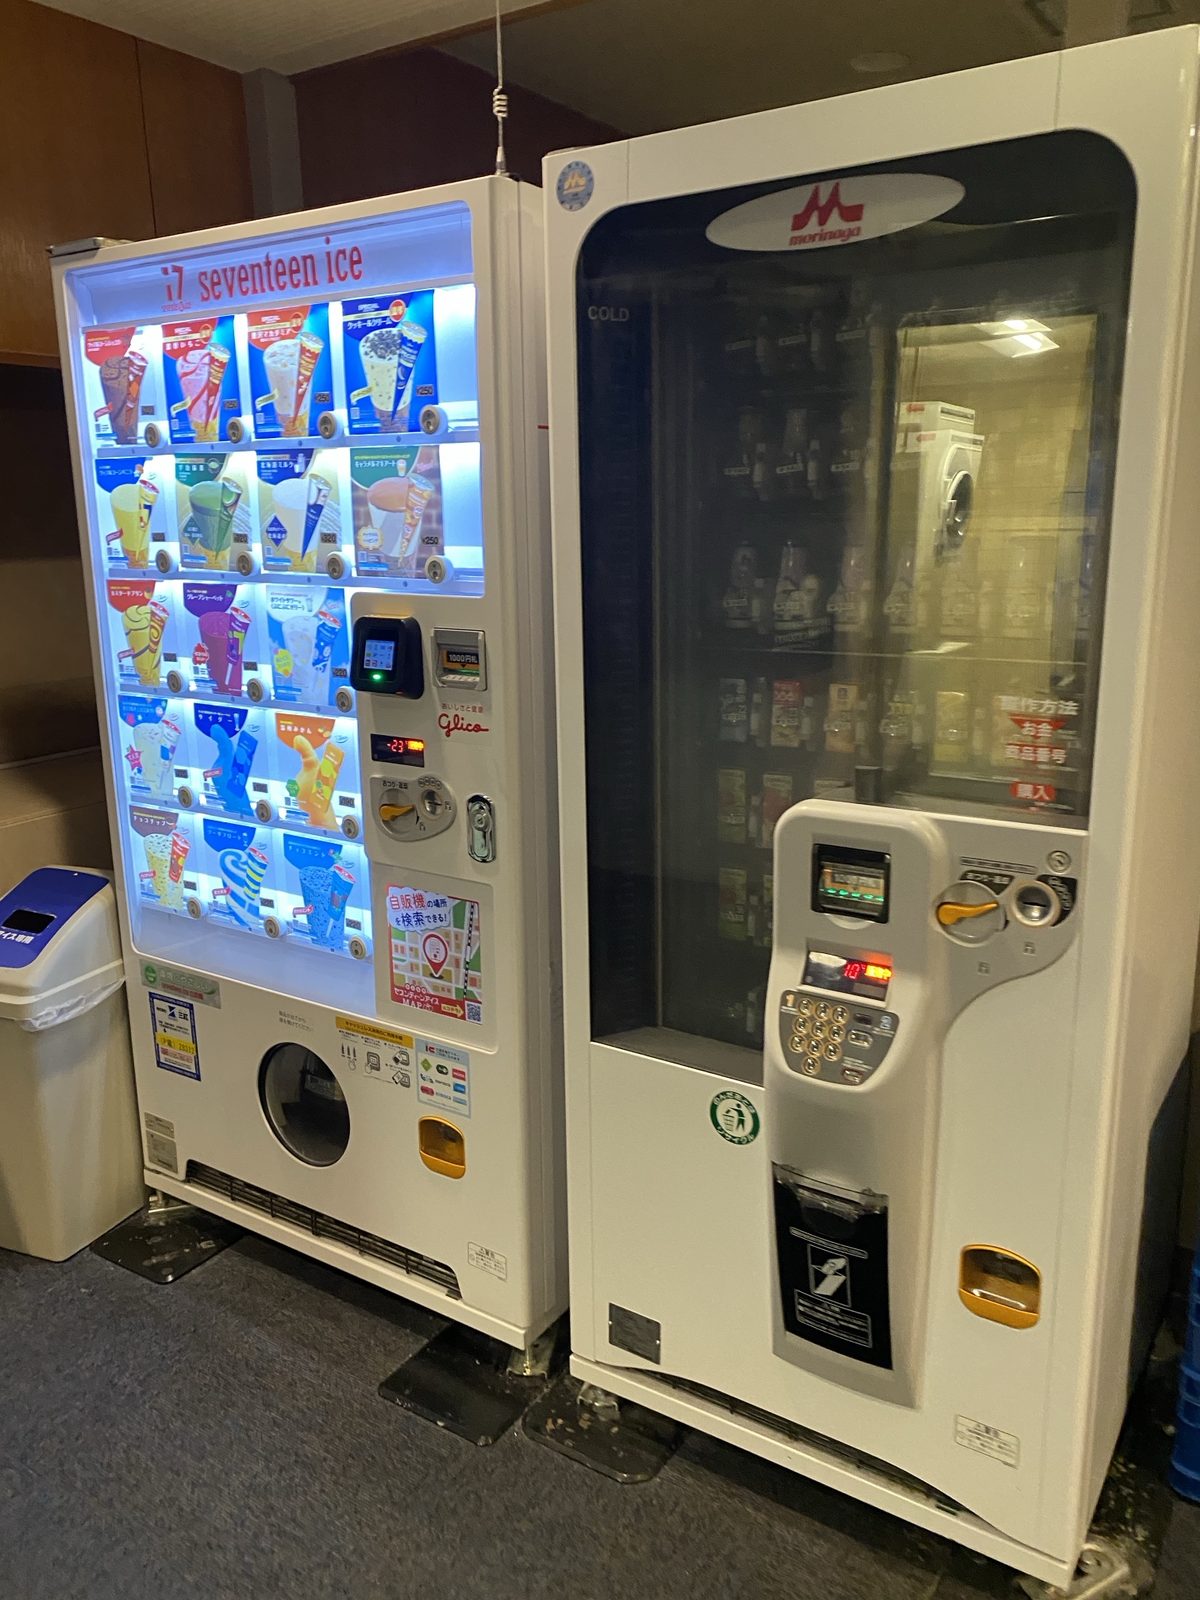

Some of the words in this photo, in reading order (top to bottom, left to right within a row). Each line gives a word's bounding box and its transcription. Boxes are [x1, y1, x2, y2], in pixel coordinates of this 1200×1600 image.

[789, 225, 861, 246] morinaga
[198, 253, 318, 302] seventeen
[326, 236, 363, 281] ice
[587, 305, 629, 322] COLD
[438, 713, 489, 737] Glico
[389, 892, 448, 911] 自販機の場所
